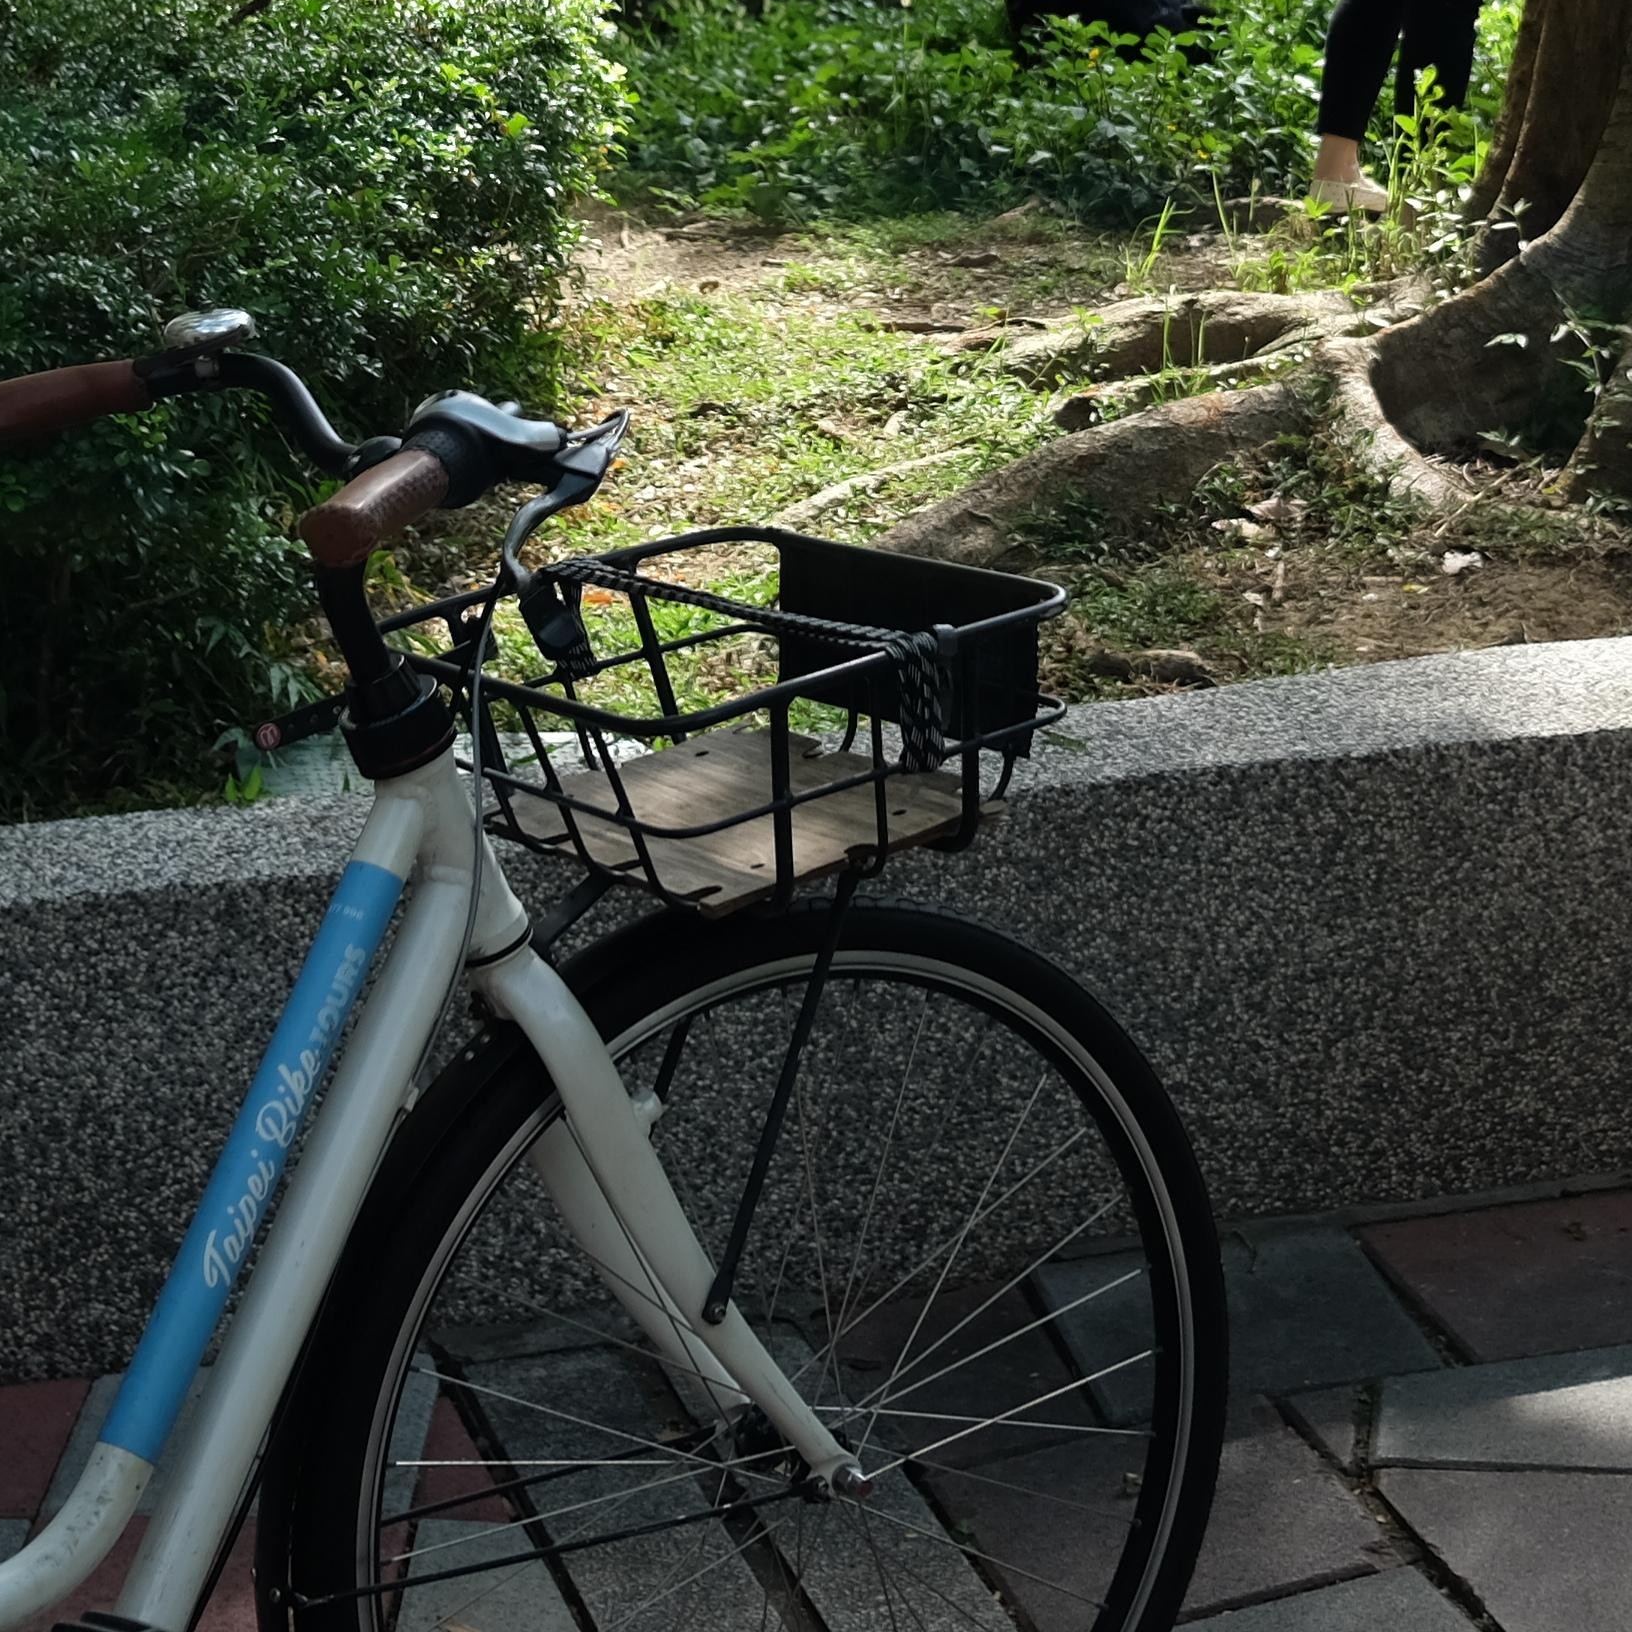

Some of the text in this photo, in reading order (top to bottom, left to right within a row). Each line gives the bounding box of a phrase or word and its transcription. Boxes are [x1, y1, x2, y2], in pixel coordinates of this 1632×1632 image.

[202, 1148, 276, 1289] Taipei
[255, 1047, 322, 1149] Bike
[309, 943, 367, 1049] TOURS
